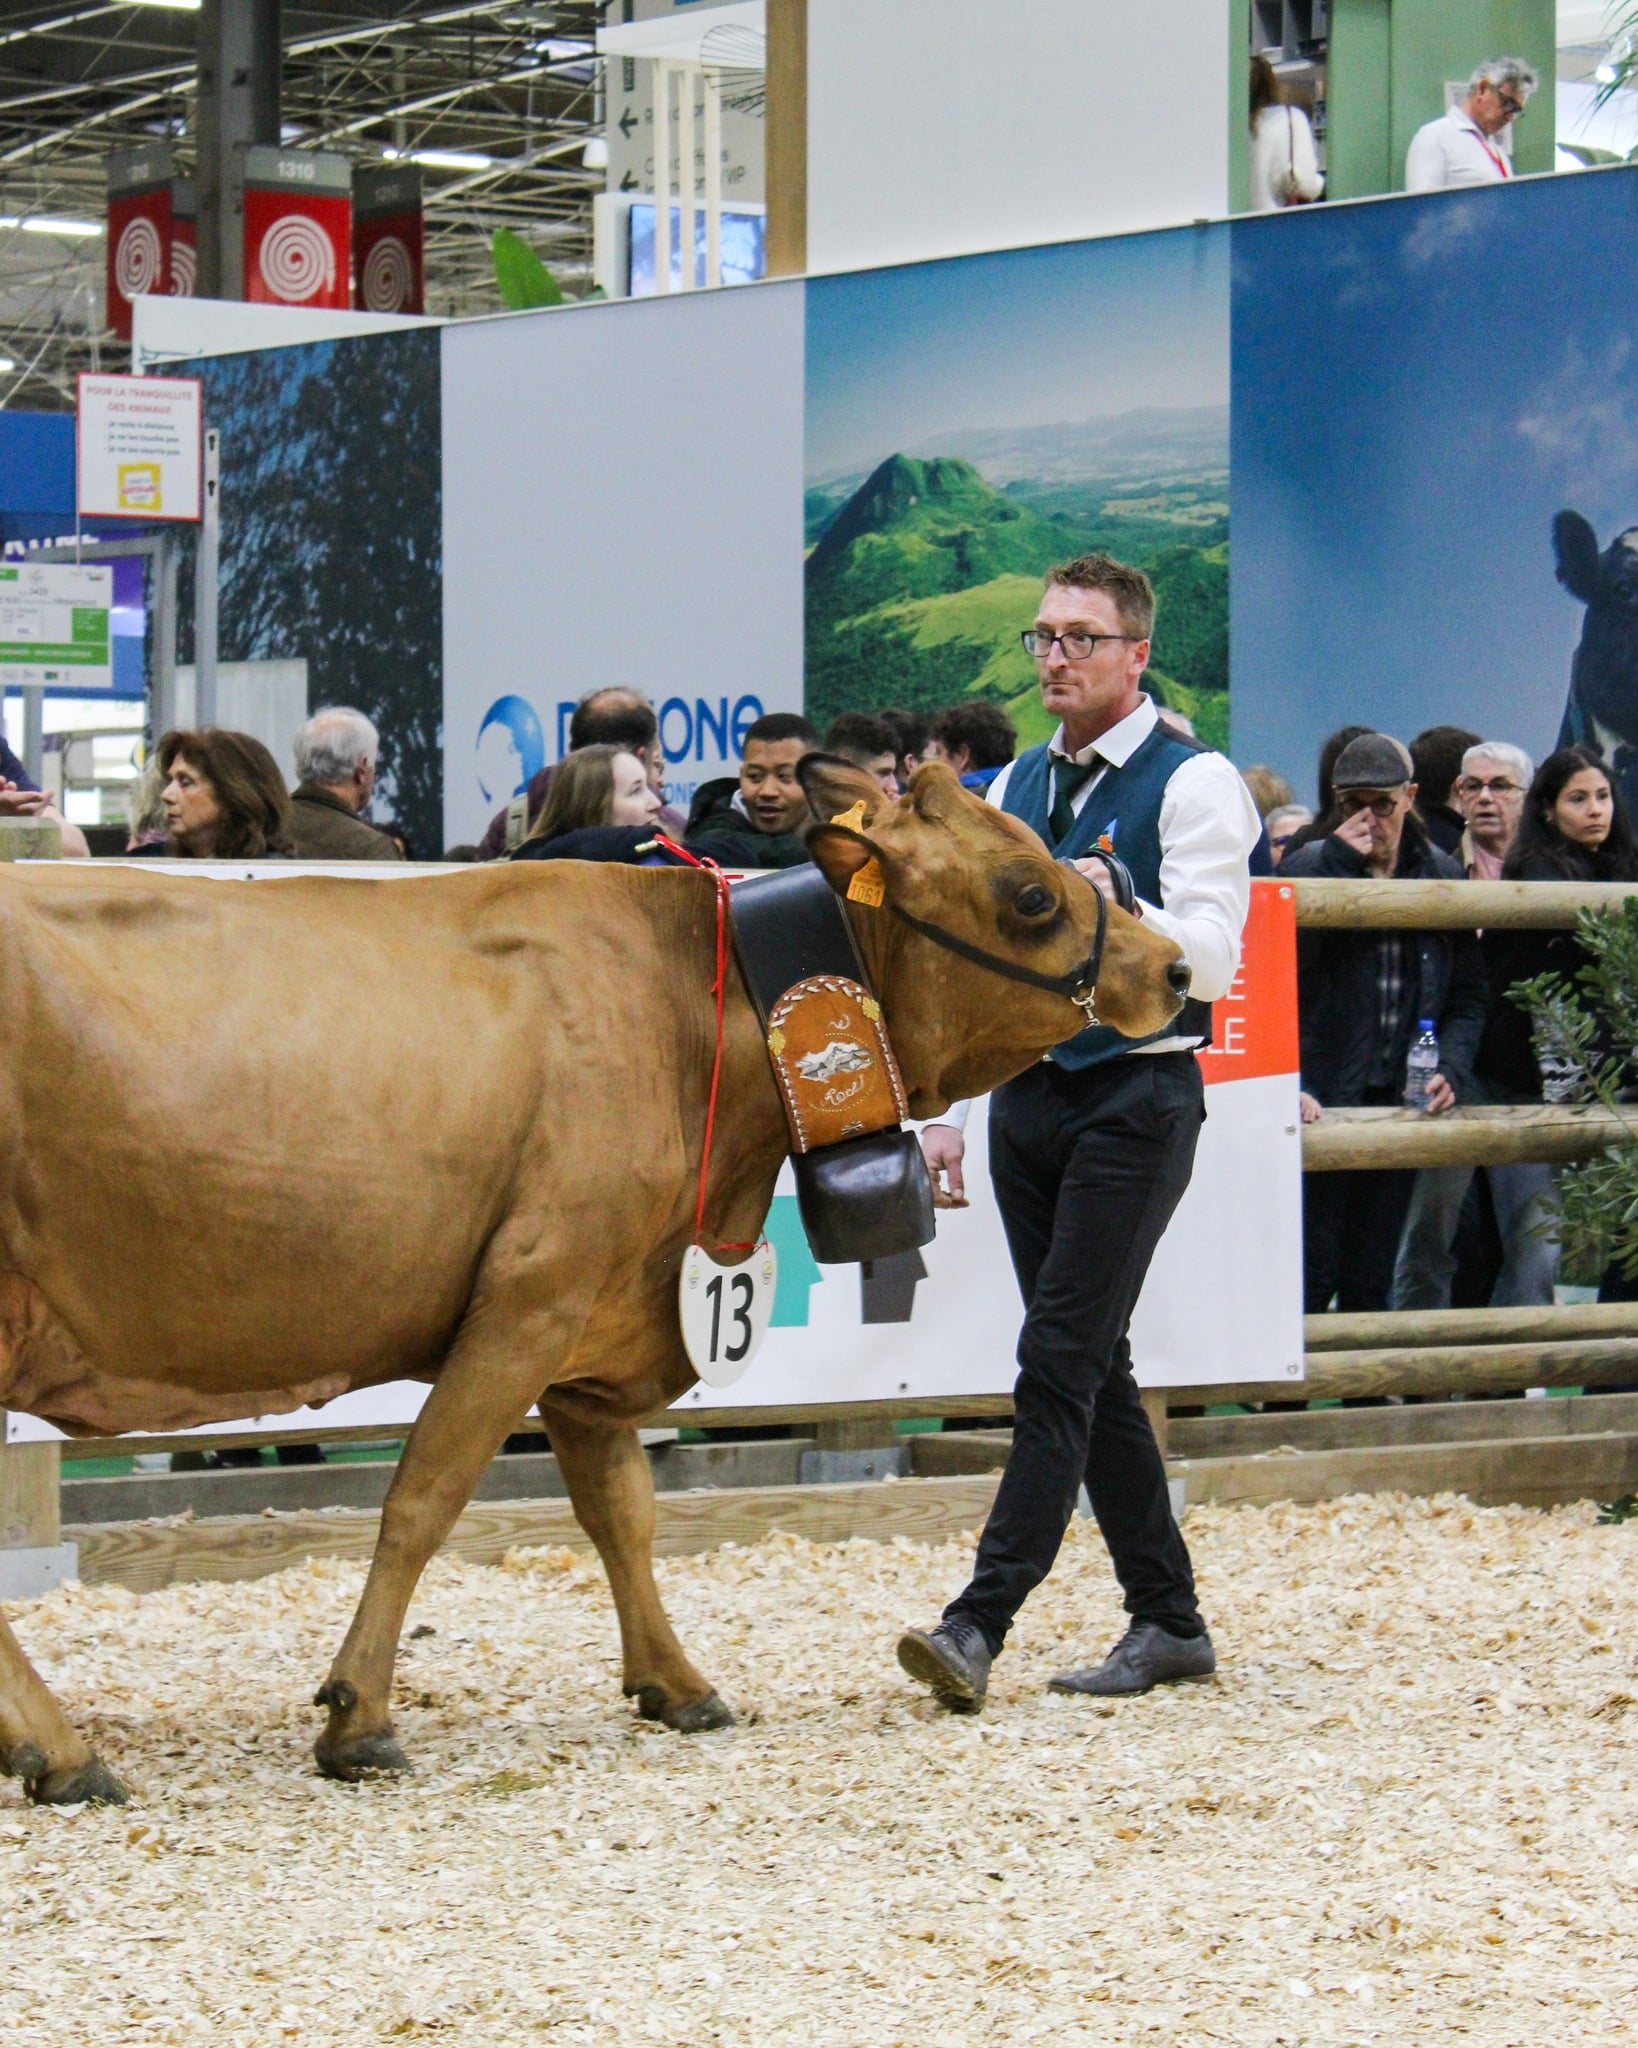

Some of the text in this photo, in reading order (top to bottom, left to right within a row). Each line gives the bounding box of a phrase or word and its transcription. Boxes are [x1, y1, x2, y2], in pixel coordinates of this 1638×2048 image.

[277, 160, 315, 179] 1310
[86, 385, 113, 396] POUR
[115, 387, 126, 397] LA
[108, 402, 172, 414] DES ANIMAUX
[706, 1272, 754, 1363] 13
